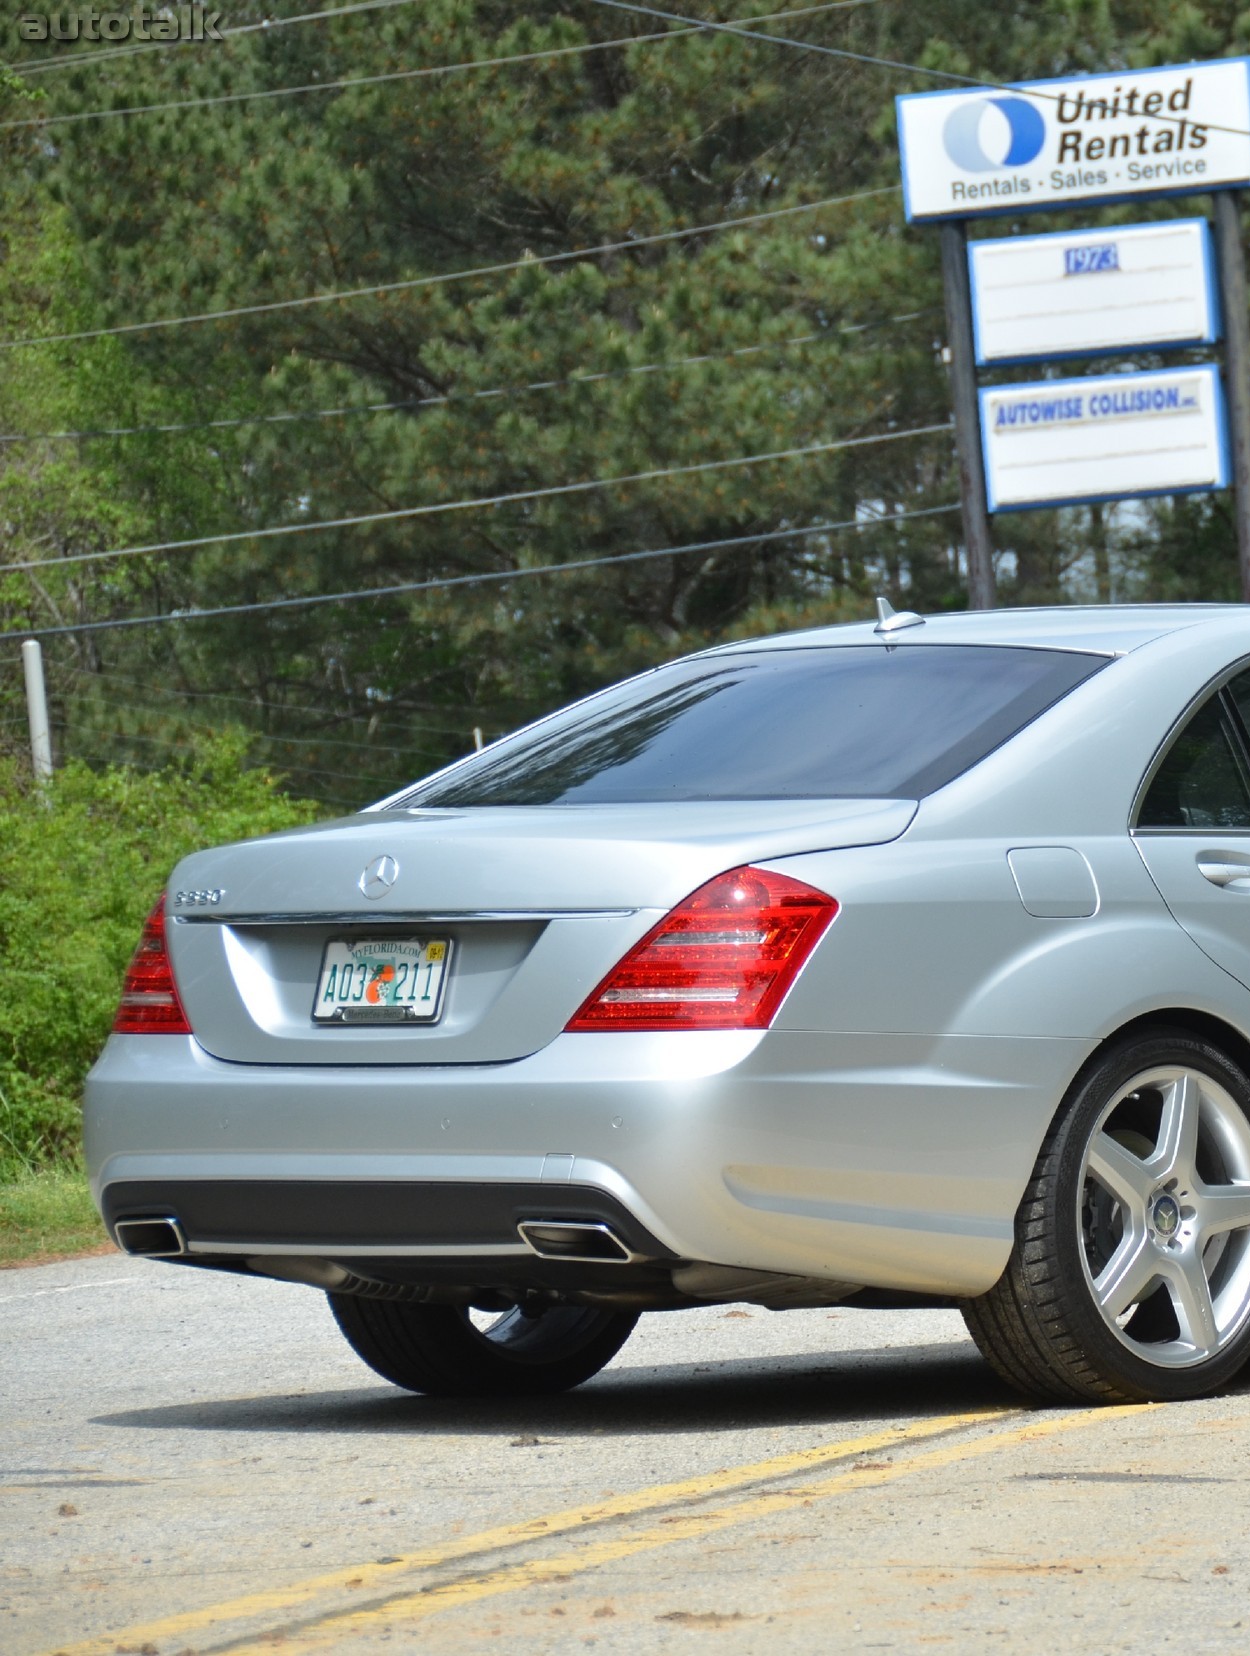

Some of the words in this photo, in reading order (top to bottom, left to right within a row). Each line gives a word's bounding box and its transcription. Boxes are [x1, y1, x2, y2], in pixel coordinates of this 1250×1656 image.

[1057, 78, 1193, 124] United
[1057, 120, 1209, 164] Rentals
[951, 174, 1031, 200] Rentals
[1050, 167, 1108, 191] Sales
[1127, 158, 1206, 181] Service
[1067, 245, 1117, 273] 1973
[995, 396, 1083, 426] AUTOWISE
[1089, 387, 1179, 417] COLLISION
[323, 963, 367, 1003] A03
[393, 962, 433, 1001] 211
